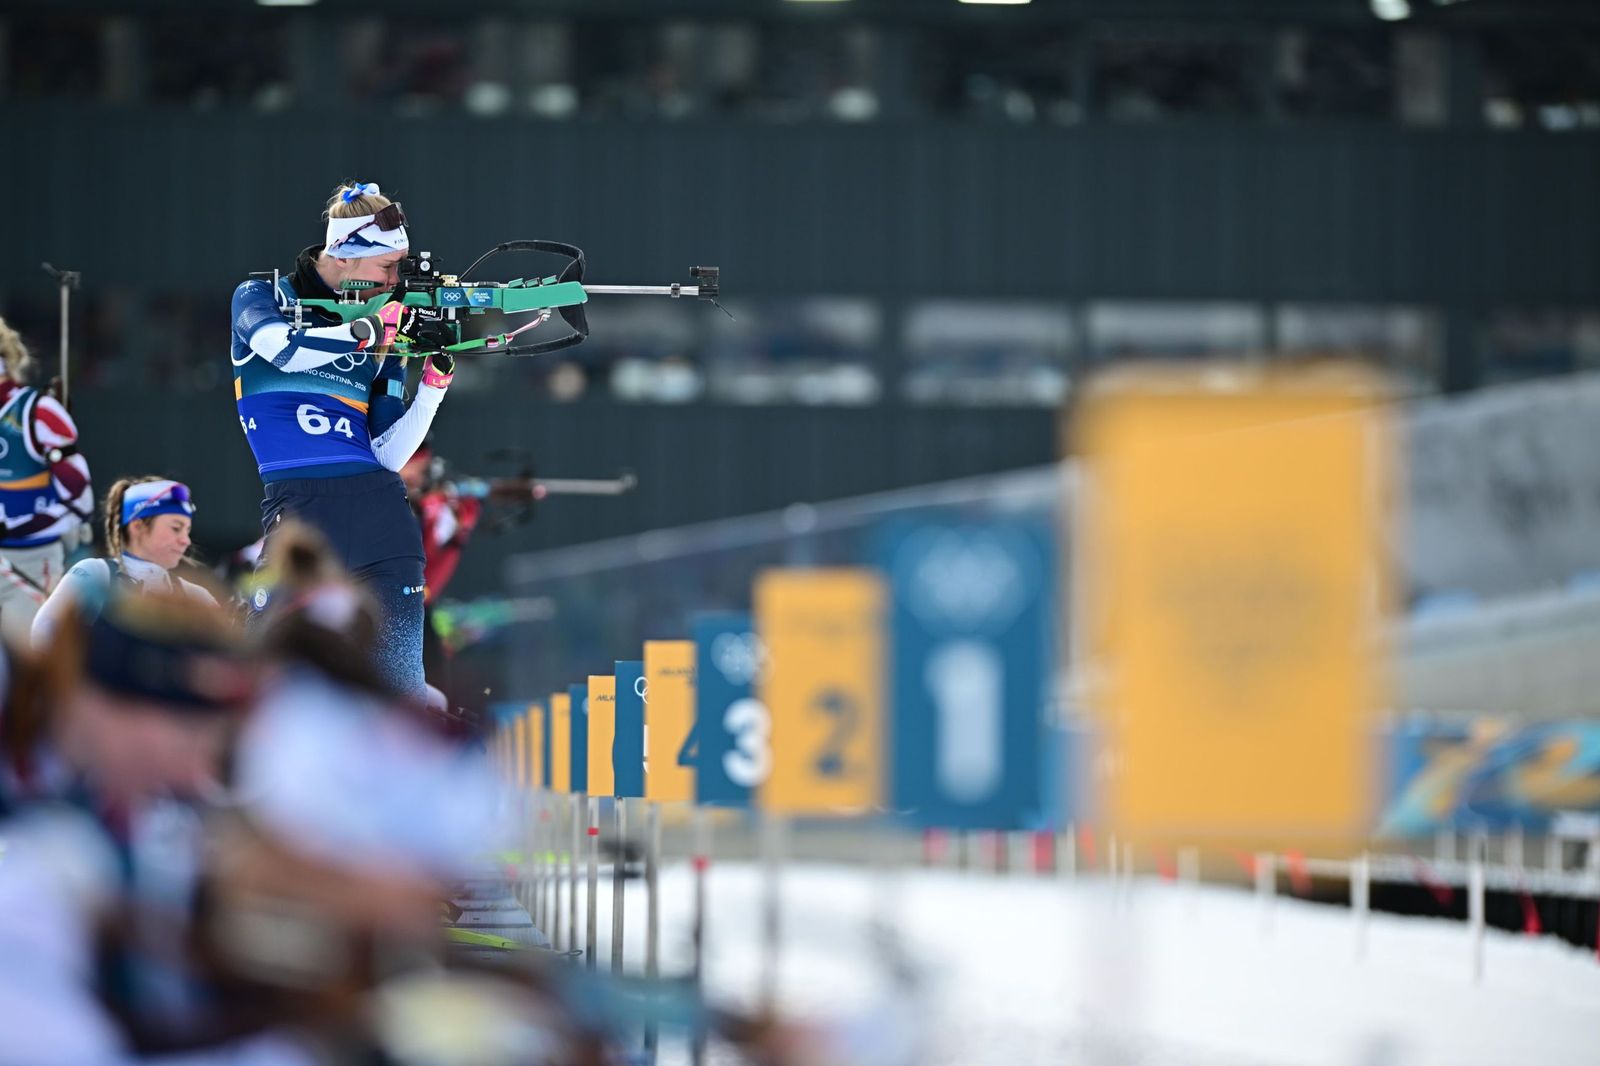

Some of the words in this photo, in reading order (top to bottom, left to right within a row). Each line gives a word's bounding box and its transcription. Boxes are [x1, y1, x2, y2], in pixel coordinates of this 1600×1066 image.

[296, 404, 355, 438] 64
[318, 370, 353, 386] CORTINA
[354, 381, 367, 392] 2026
[721, 697, 774, 787] 3
[806, 684, 876, 783] 2
[924, 638, 1005, 804] 1
